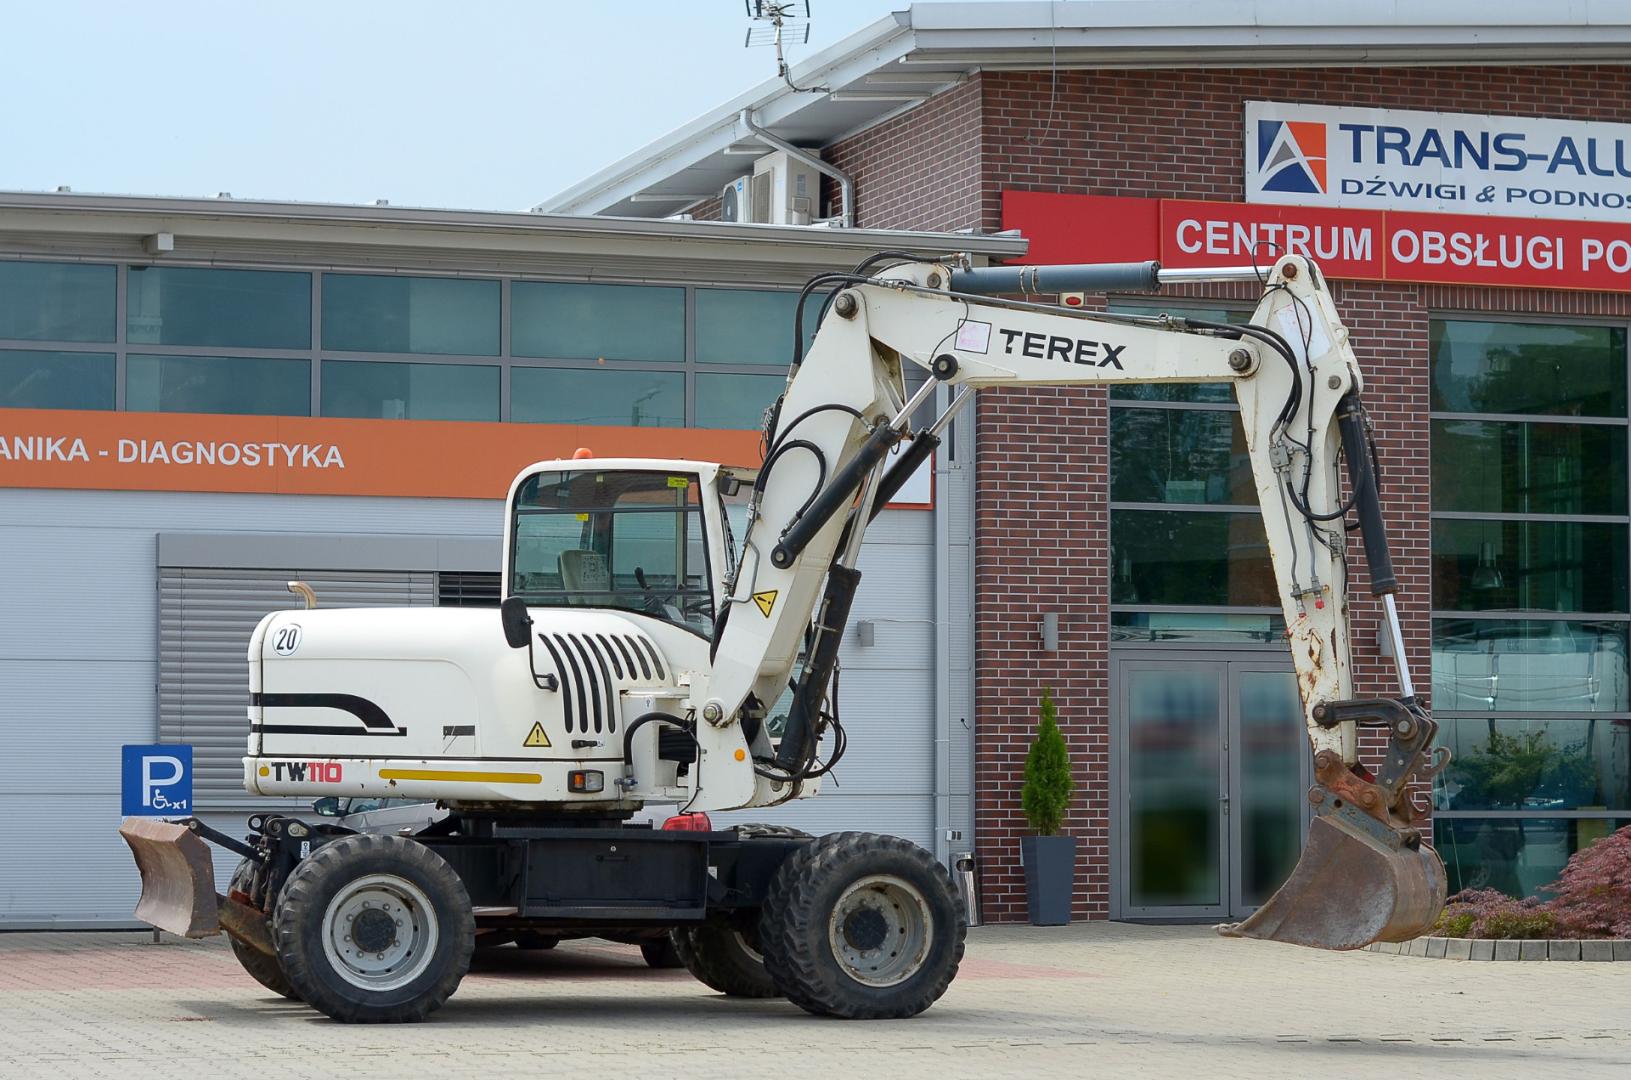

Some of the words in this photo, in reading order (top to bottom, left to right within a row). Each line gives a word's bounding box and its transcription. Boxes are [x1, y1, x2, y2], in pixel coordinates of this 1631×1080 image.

[1341, 175, 1466, 200] DŹWIGI
[1475, 185, 1496, 203] &
[1506, 187, 1631, 209] PODNO
[1176, 219, 1372, 261] CENTRUM
[1391, 229, 1564, 271] OBSŁUGI
[1000, 328, 1127, 371] TEREX
[117, 438, 345, 468] DIAGNOSTYKA
[276, 628, 298, 650] 20
[142, 755, 184, 807] P
[271, 762, 342, 783] TW110
[172, 799, 187, 809] x1
